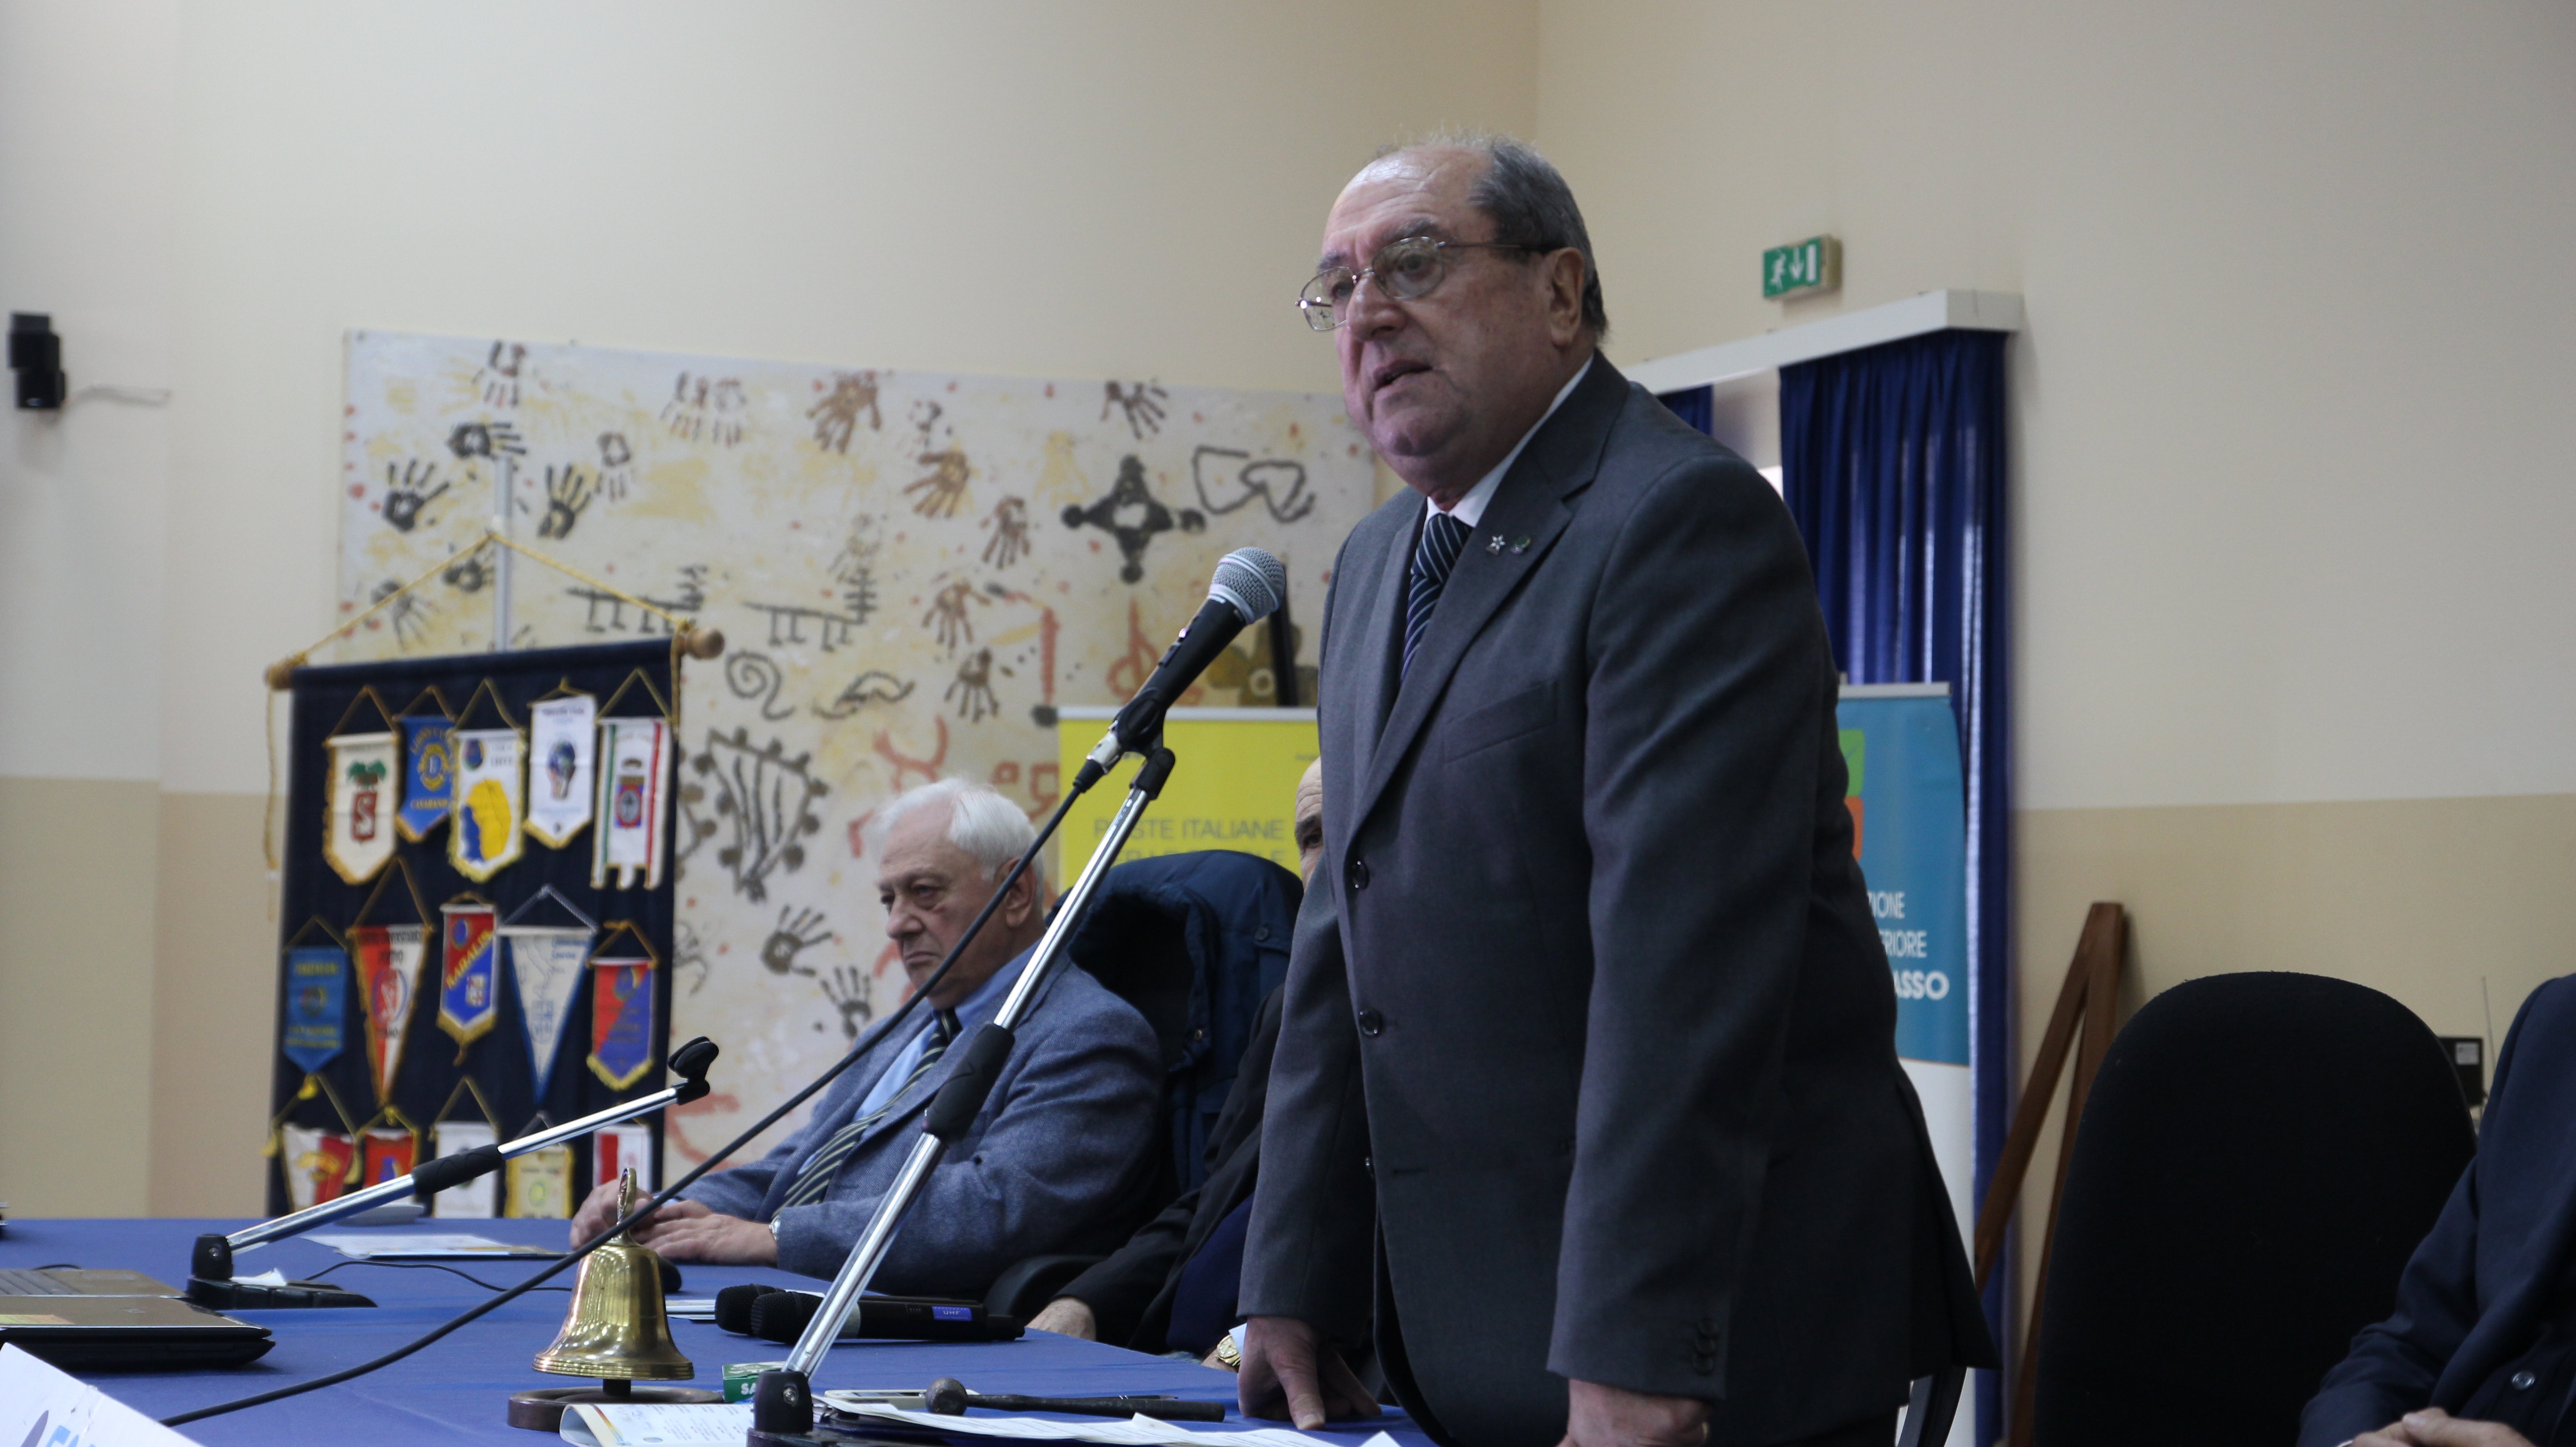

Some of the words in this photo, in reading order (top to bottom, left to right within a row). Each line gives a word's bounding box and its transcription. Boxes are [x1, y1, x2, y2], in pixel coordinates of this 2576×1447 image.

[1094, 818, 1174, 840] PSTE
[1182, 818, 1285, 840] ITALIANE
[741, 1382, 756, 1395] SA
